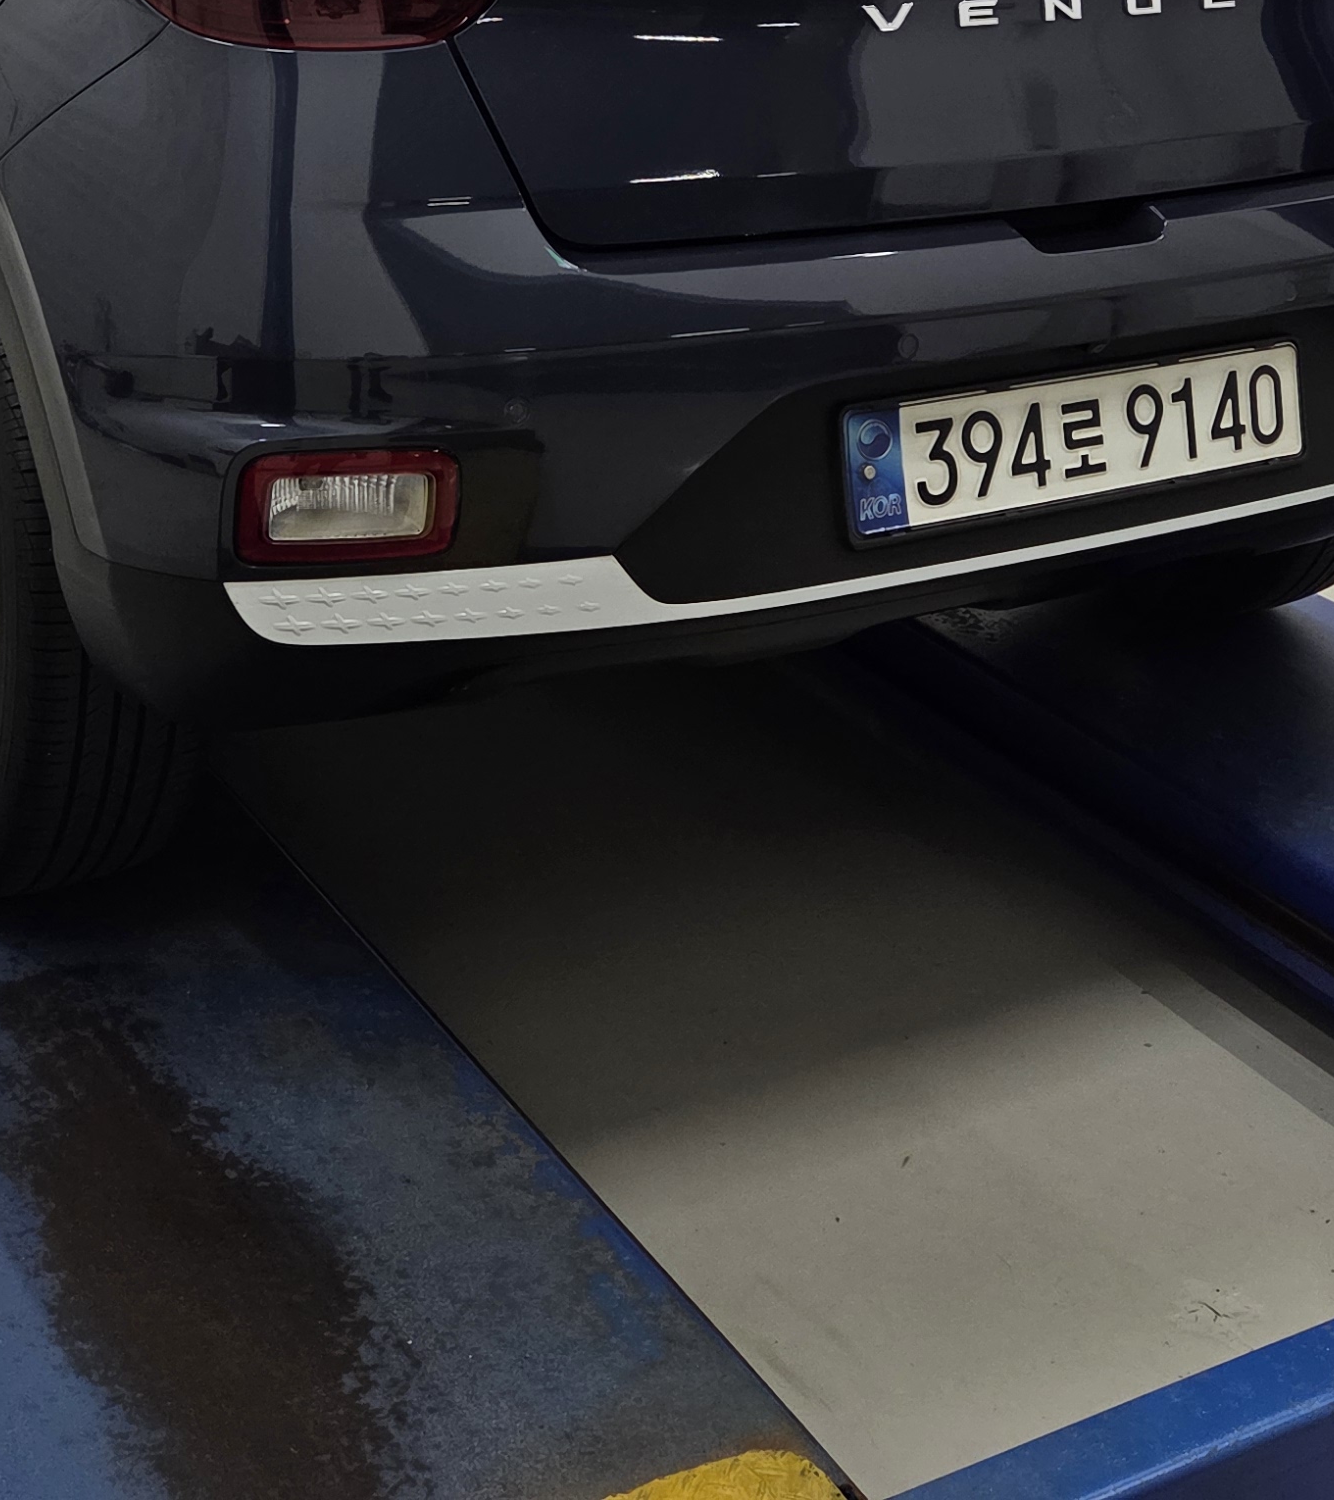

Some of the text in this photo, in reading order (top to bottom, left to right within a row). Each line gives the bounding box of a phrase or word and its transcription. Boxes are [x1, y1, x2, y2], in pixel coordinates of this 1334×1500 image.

[914, 364, 1285, 507] 394로 9140
[858, 493, 903, 523] KOR
